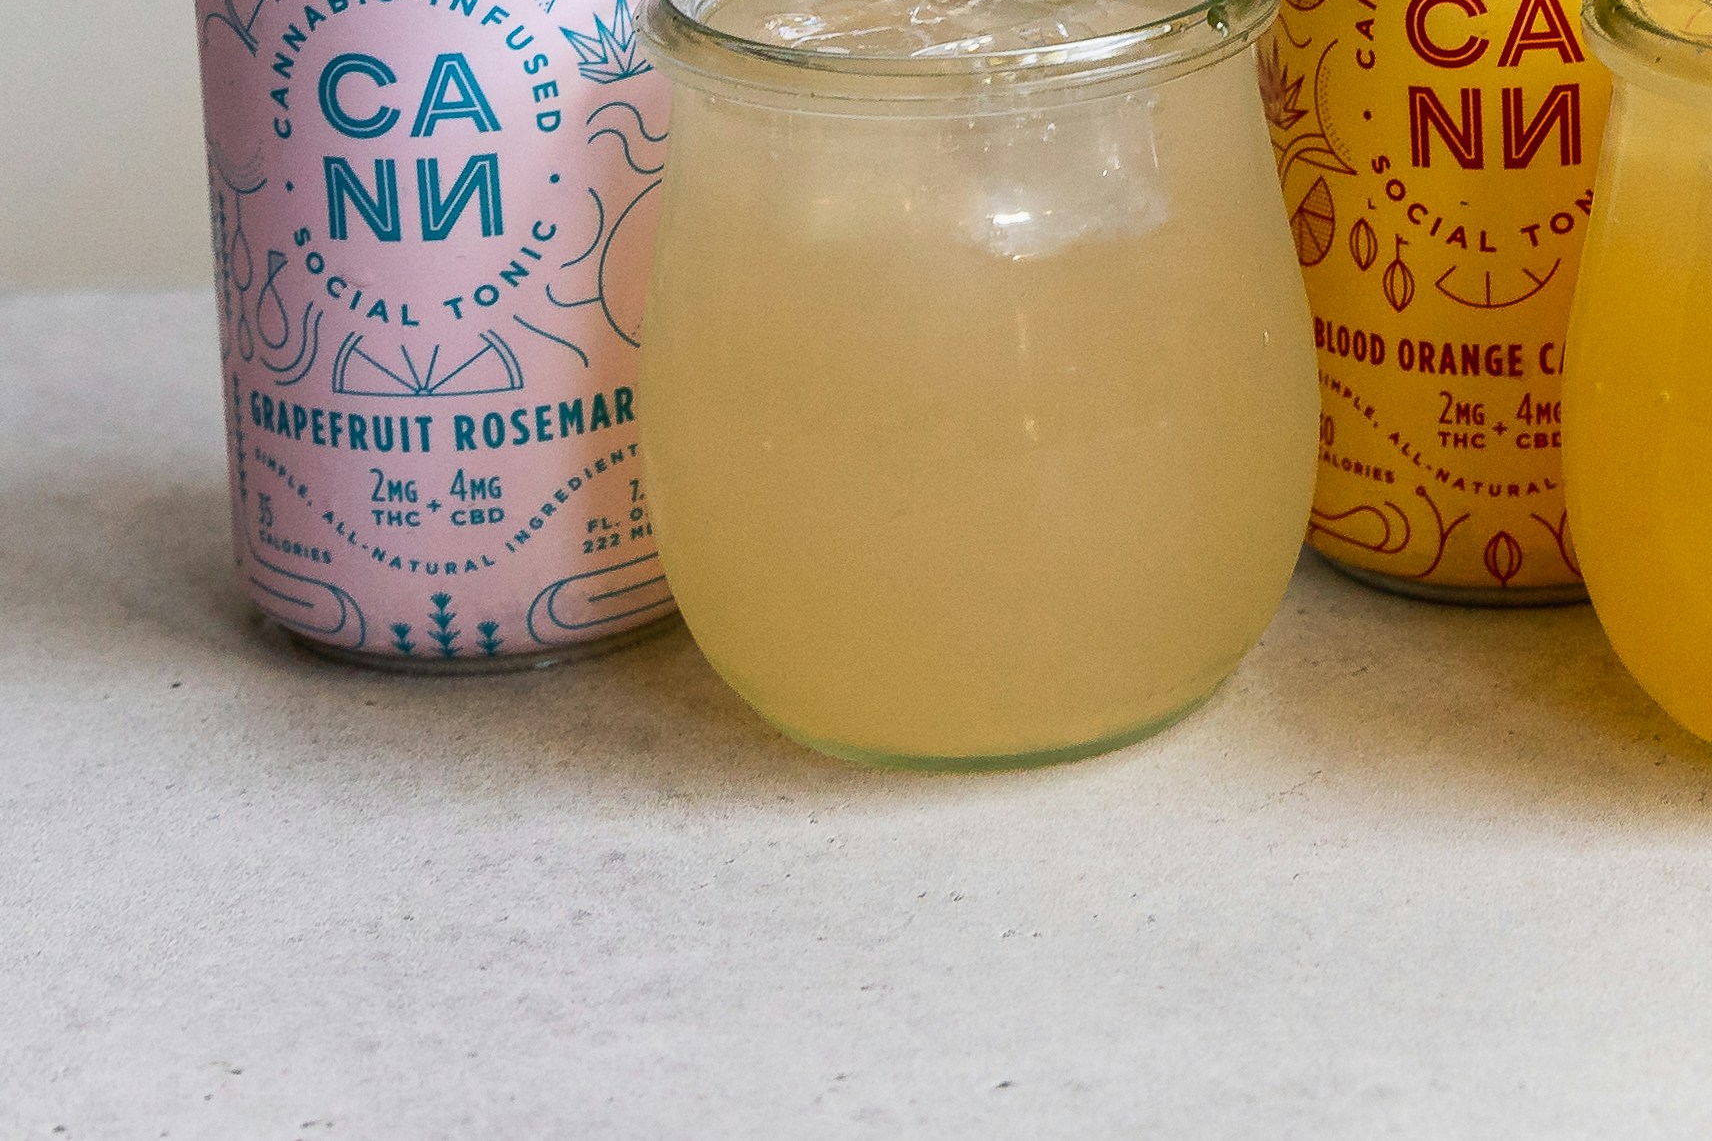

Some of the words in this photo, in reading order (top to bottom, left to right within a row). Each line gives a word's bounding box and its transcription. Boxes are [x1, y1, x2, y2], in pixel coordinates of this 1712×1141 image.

[318, 52, 502, 139] CA
[1371, 155, 1498, 252] SOCIAL
[1520, 189, 1594, 247] TON
[293, 225, 419, 326] SOCIAL
[443, 220, 557, 320] TONIC
[1314, 316, 1386, 366] BLOOD
[1398, 339, 1523, 377] ORANGE
[1539, 340, 1566, 376] C
[250, 389, 432, 452] GRAPEFRUIT
[454, 386, 634, 451] ROSEMAR
[1319, 369, 1379, 429] IMPLE,
[1388, 431, 1557, 497] ALL-NATURAL
[1439, 390, 1485, 425] 2MG
[1319, 451, 1395, 484] ALORIES
[1438, 431, 1486, 449] THC
[369, 467, 418, 503] 2MG
[450, 467, 502, 501] 4MG
[505, 443, 638, 553] INGREDIENT
[629, 507, 645, 521] O
[371, 509, 421, 526] THC
[450, 507, 505, 527] CBD
